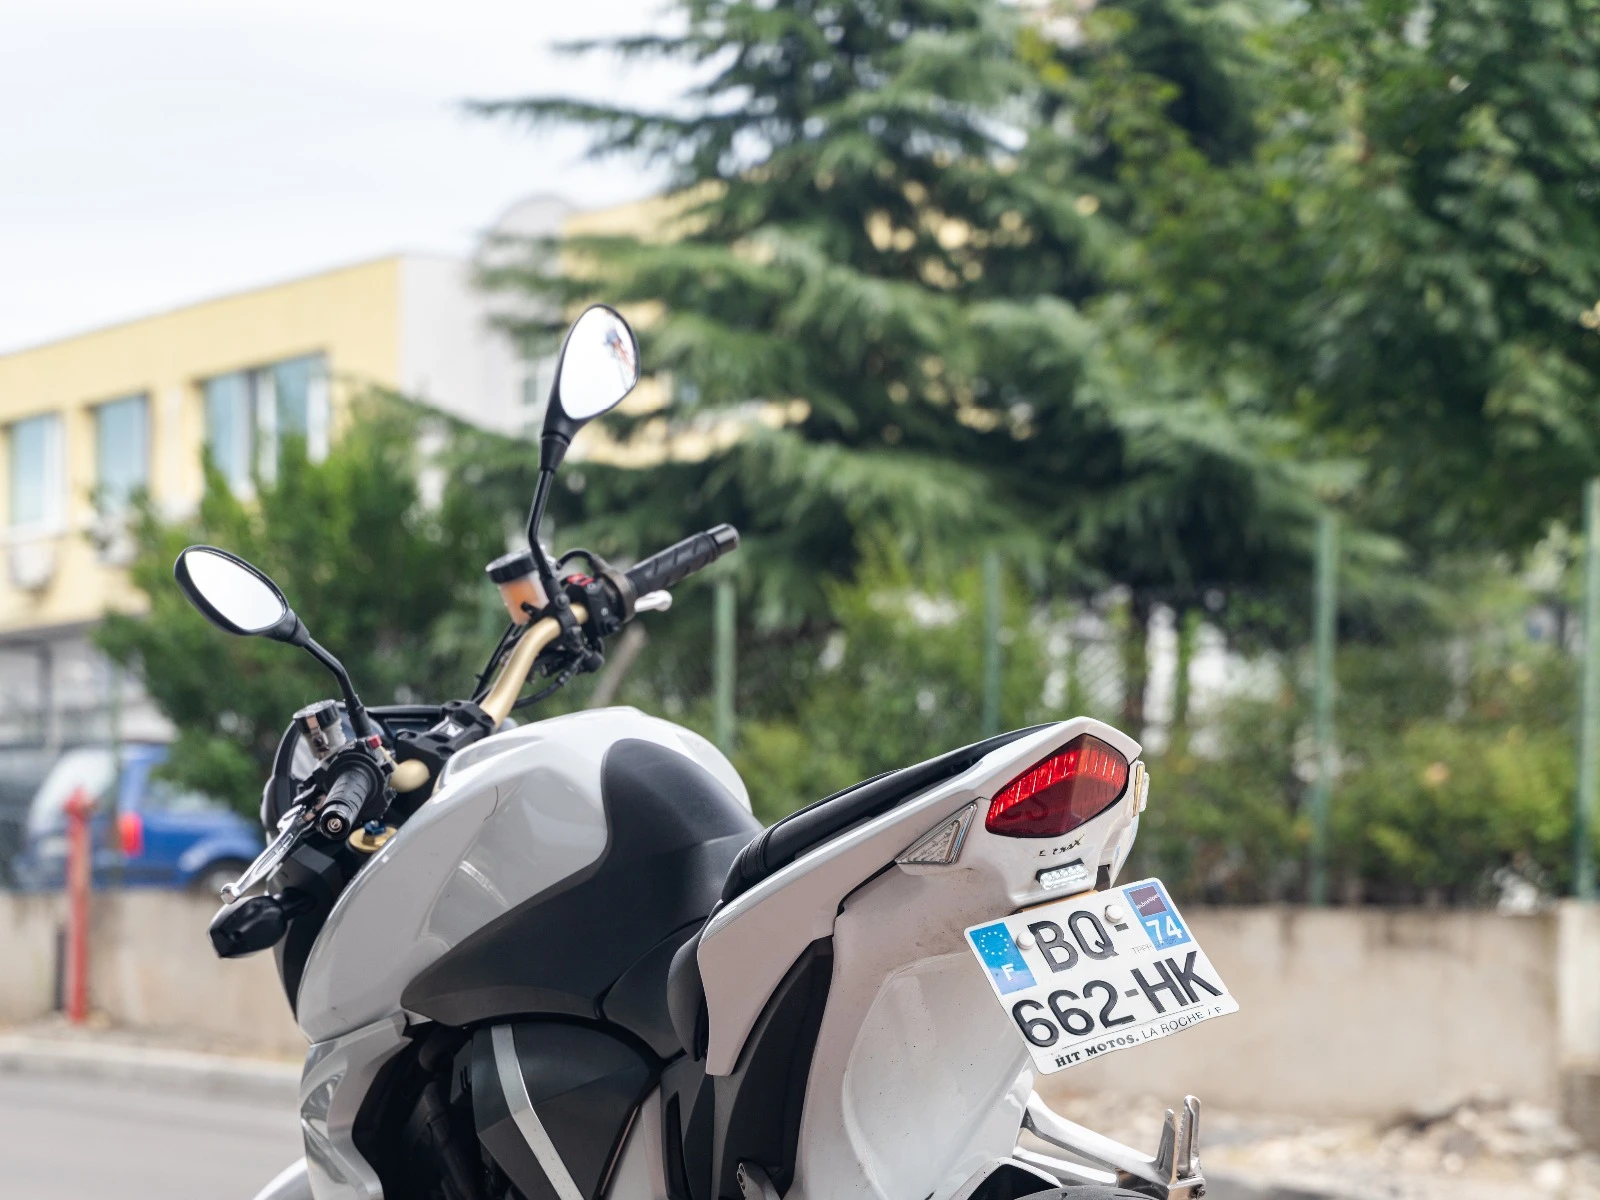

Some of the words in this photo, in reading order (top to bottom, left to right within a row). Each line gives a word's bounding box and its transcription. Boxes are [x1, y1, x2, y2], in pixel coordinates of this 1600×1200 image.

[1145, 915, 1183, 945] 74
[1002, 963, 1015, 982] F
[1011, 950, 1223, 1048] 662-HK
[1055, 1052, 1080, 1068] HIT
[1086, 1035, 1140, 1057] MOTOS.
[1141, 1029, 1158, 1040] LA
[1161, 1012, 1204, 1034] ROCHE
